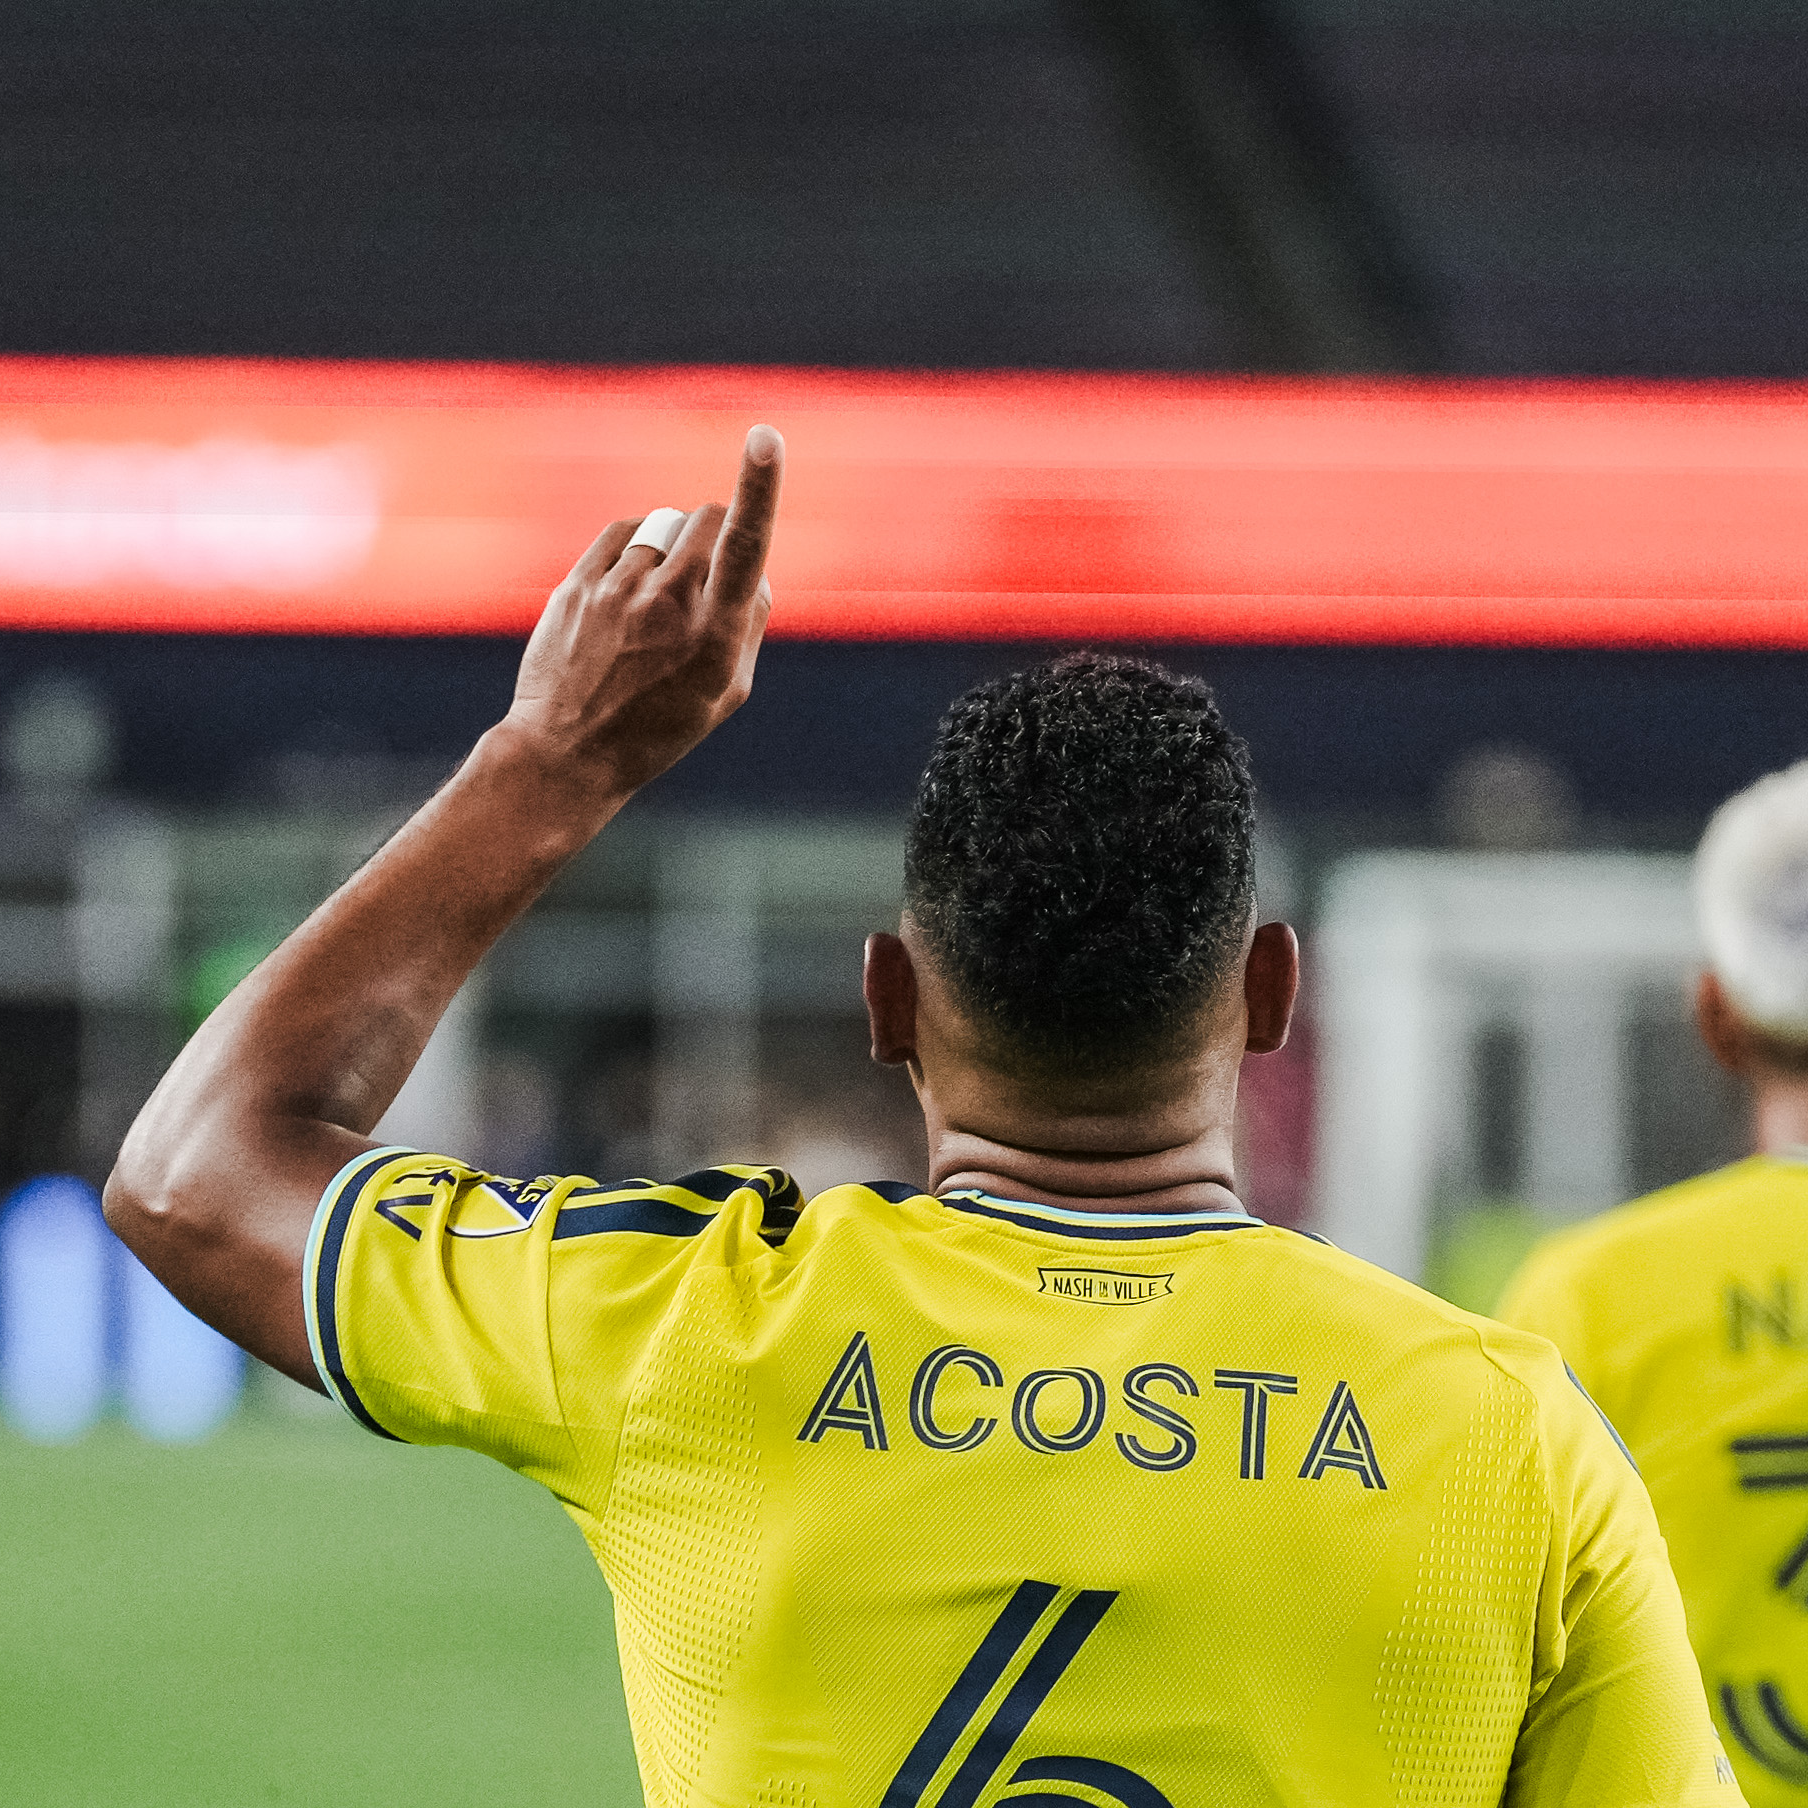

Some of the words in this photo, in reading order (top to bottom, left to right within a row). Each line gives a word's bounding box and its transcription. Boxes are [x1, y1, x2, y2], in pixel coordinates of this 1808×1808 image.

[1053, 1277, 1093, 1298] NASH
[1114, 1281, 1157, 1299] VILLE
[797, 1330, 1389, 1491] ACOSTA
